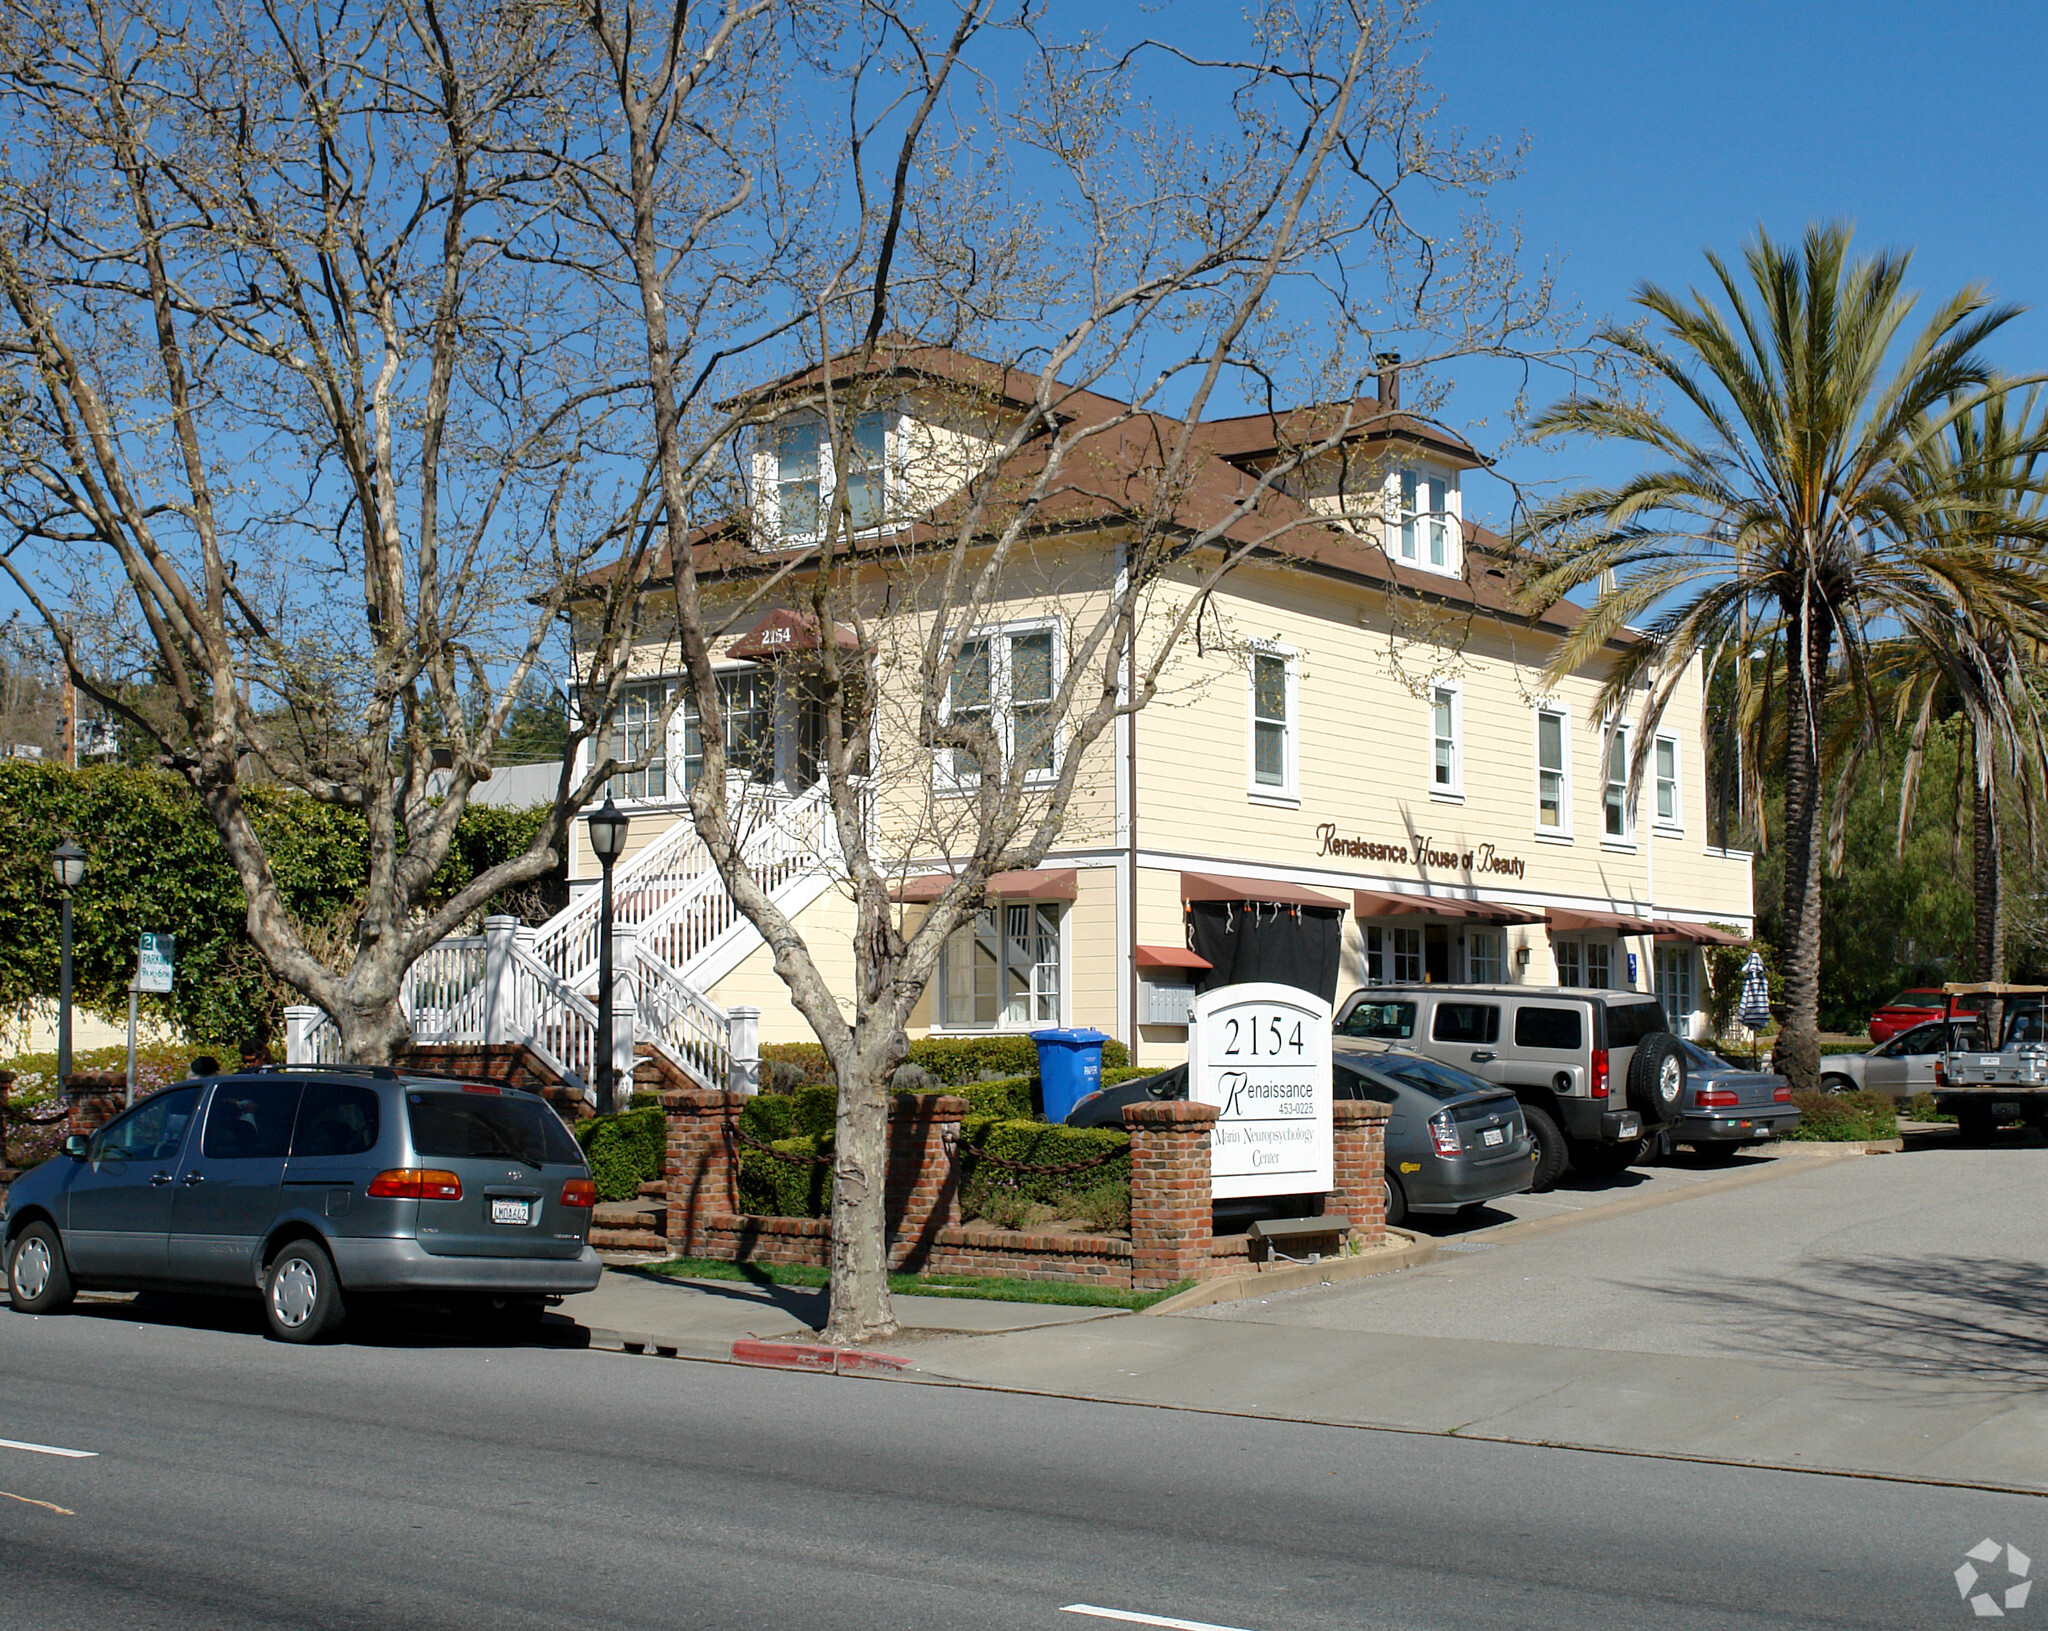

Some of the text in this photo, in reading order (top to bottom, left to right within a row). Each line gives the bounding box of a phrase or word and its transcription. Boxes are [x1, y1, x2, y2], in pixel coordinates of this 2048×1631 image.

[762, 627, 791, 645] 2154
[1316, 823, 1525, 880] Renaissance House of Beauty
[143, 935, 152, 949] 2
[1224, 1015, 1304, 1056] 2154
[1217, 1071, 1313, 1118] Renaissance
[1278, 1102, 1314, 1115] 453-0225
[1215, 1127, 1315, 1146] Marin Neuropsychology
[1252, 1149, 1280, 1168] Center
